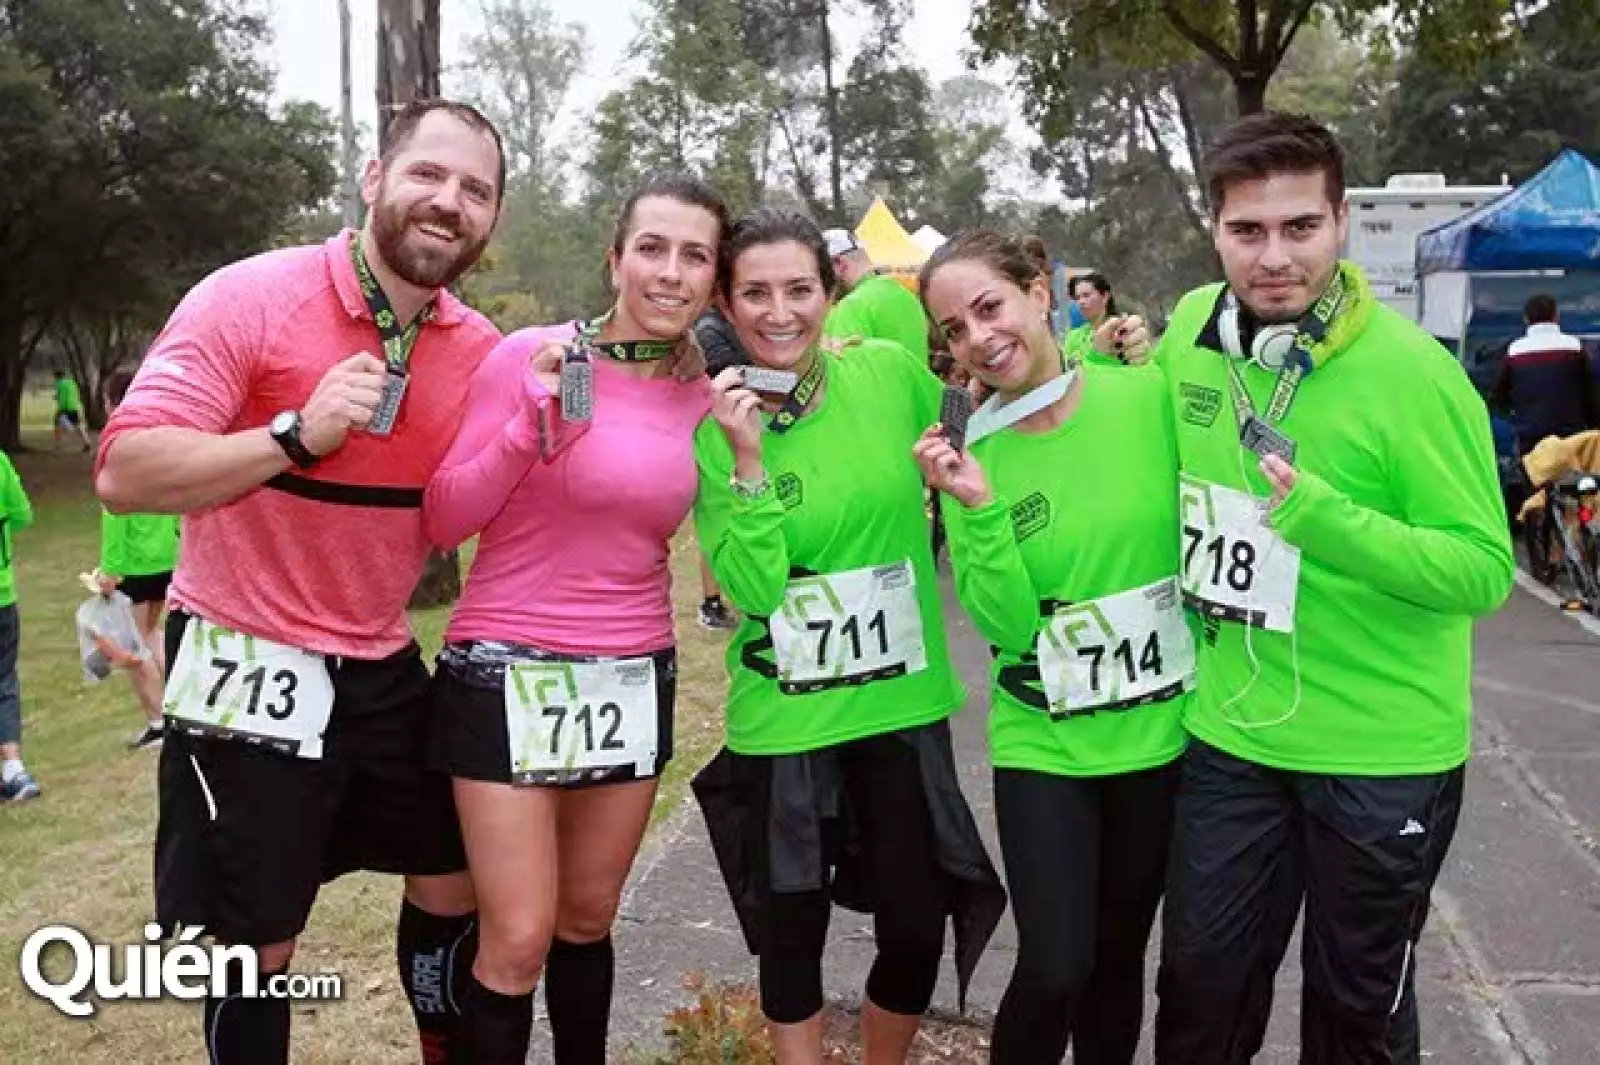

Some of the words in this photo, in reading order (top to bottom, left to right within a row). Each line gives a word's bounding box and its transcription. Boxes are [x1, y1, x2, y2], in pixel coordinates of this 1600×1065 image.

[1184, 525, 1256, 592] 718
[806, 609, 888, 667] 711
[1076, 630, 1163, 691] 714
[205, 657, 298, 721] 713
[542, 702, 626, 755] 712
